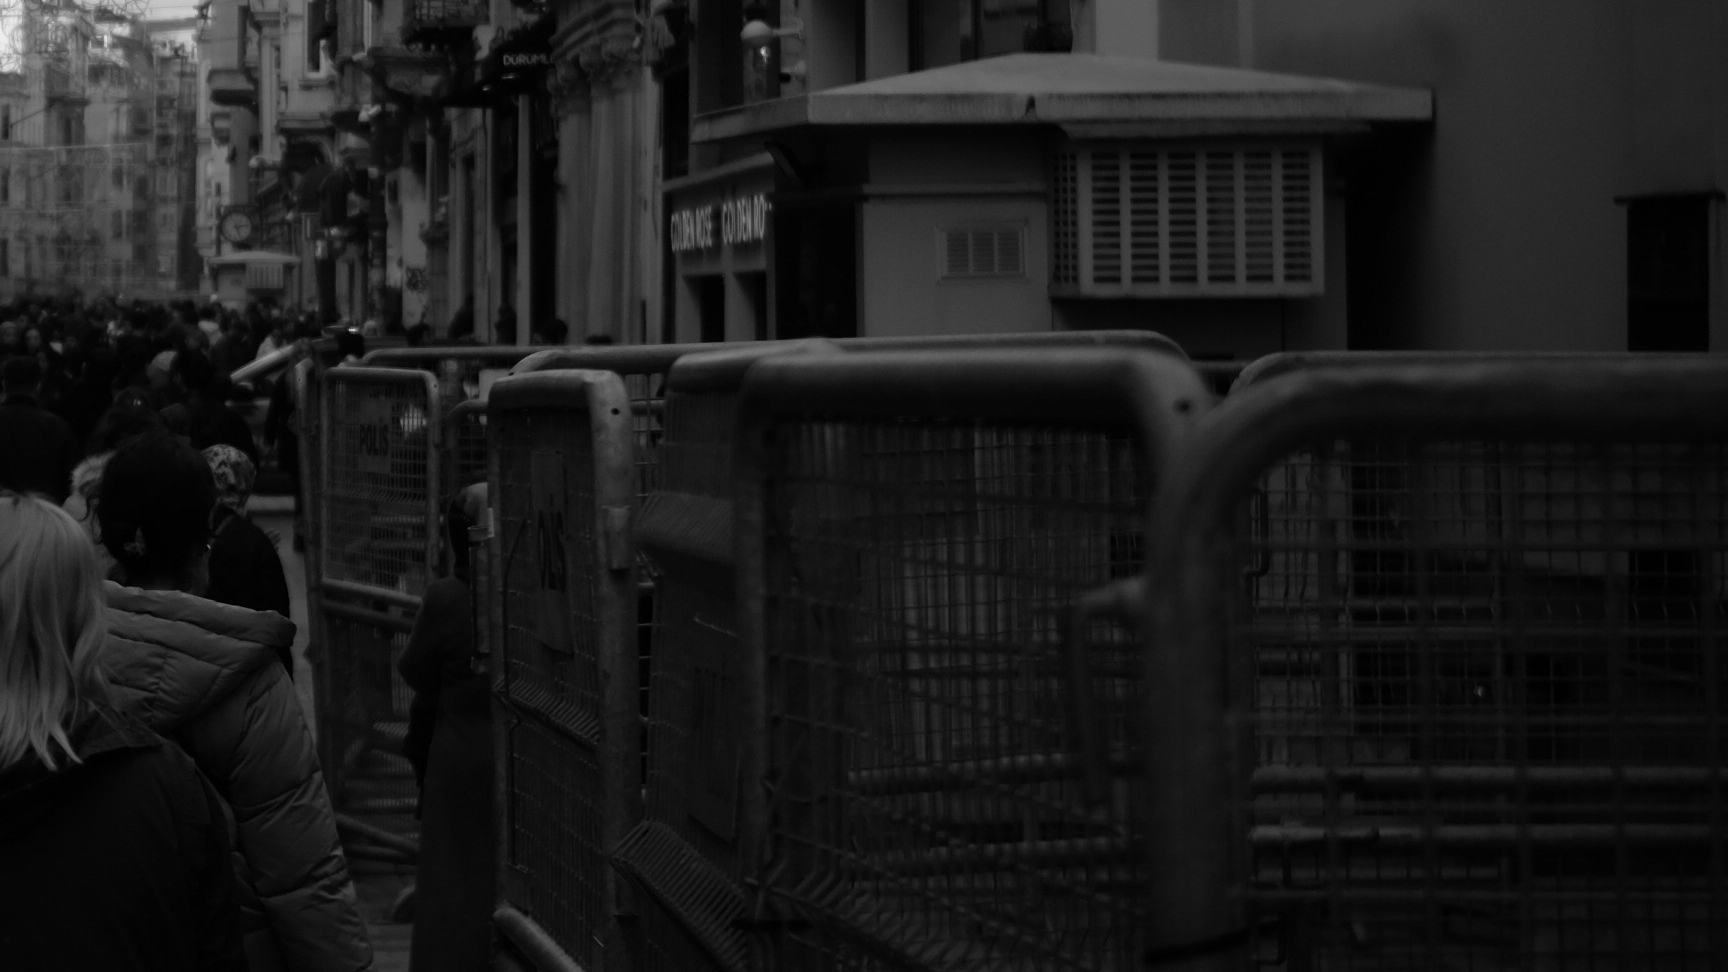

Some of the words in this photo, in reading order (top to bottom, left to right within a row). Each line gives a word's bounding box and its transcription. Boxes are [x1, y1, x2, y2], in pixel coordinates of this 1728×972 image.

[671, 209, 695, 253] GOLDEN
[722, 196, 752, 246] GOLDEN
[359, 416, 389, 457] POLİS
